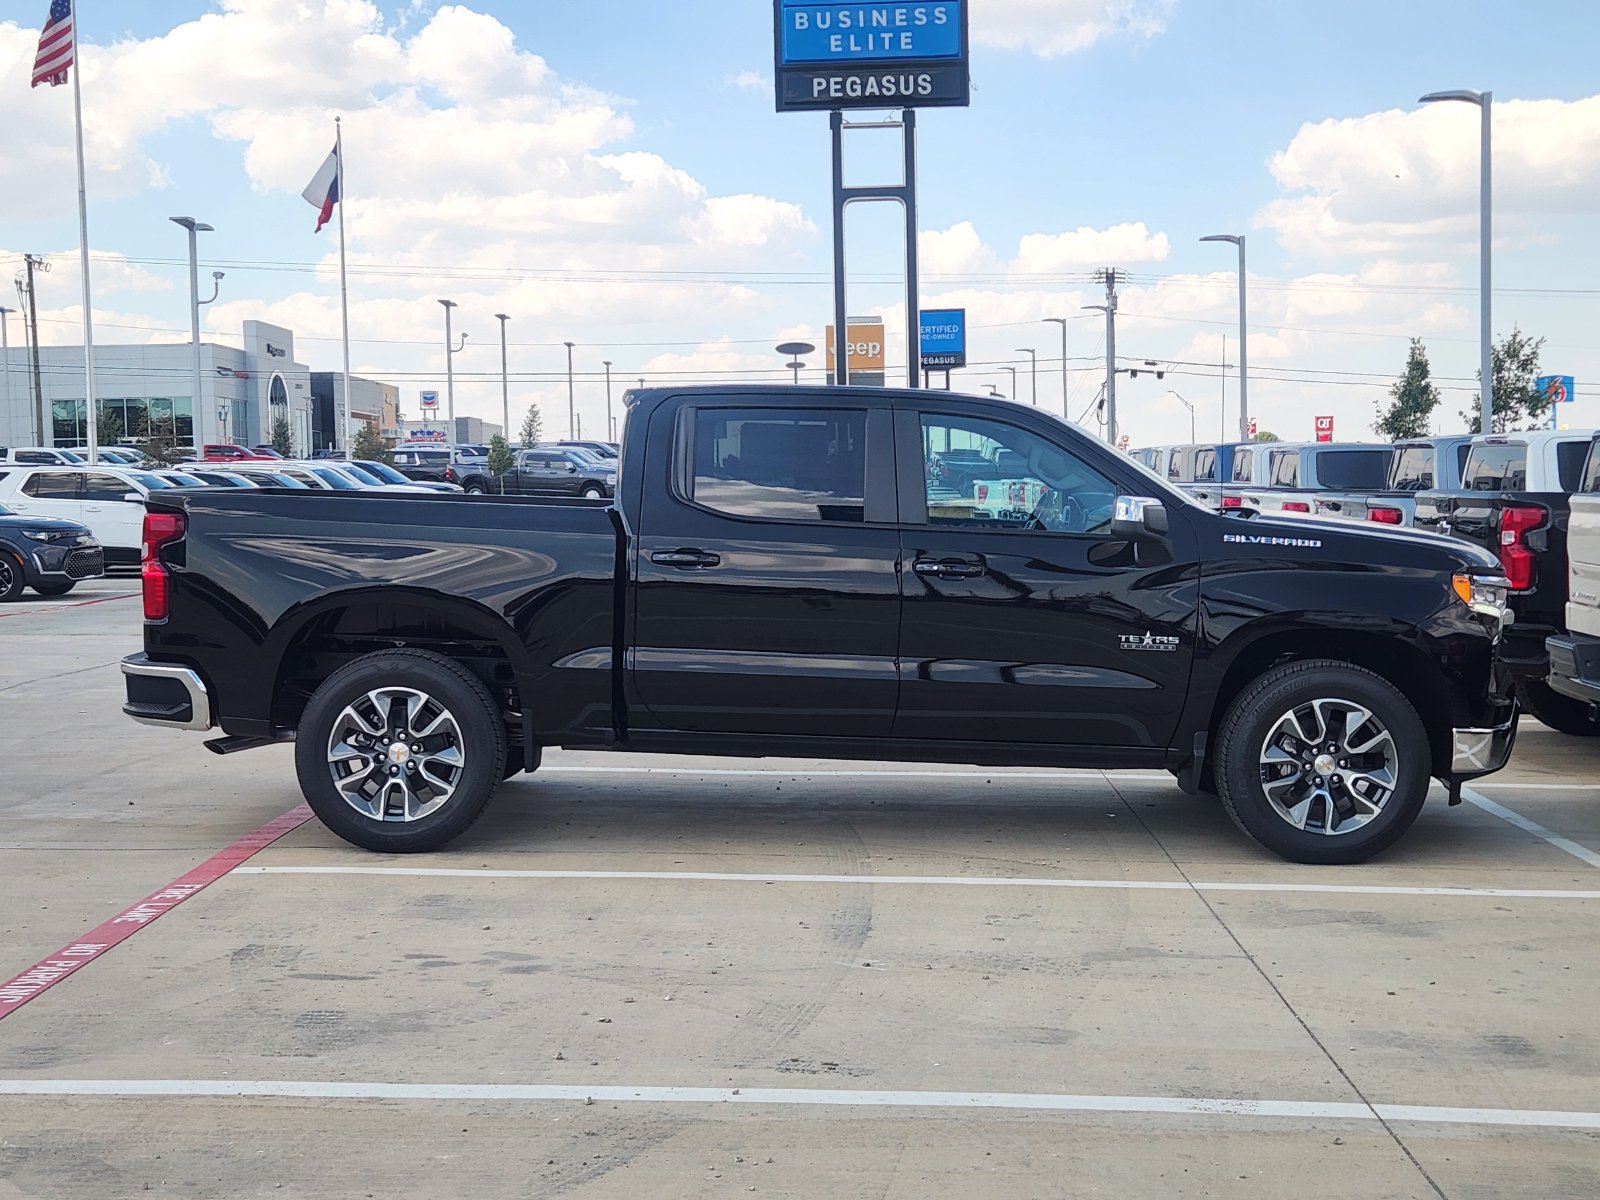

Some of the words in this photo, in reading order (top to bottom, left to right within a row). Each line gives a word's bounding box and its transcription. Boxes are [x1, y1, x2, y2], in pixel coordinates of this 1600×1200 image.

[795, 7, 947, 30] BUSINESS
[830, 32, 913, 52] ELITE
[813, 74, 932, 98] PEGASUS
[920, 325, 959, 334] ERTIFIED
[830, 341, 881, 358] eep
[1317, 418, 1331, 429] QT
[1223, 534, 1322, 548] SILVERADO
[152, 884, 204, 900] FIRE
[112, 902, 173, 924] LANE
[61, 943, 108, 956] NO
[0, 960, 81, 1003] PARKING
